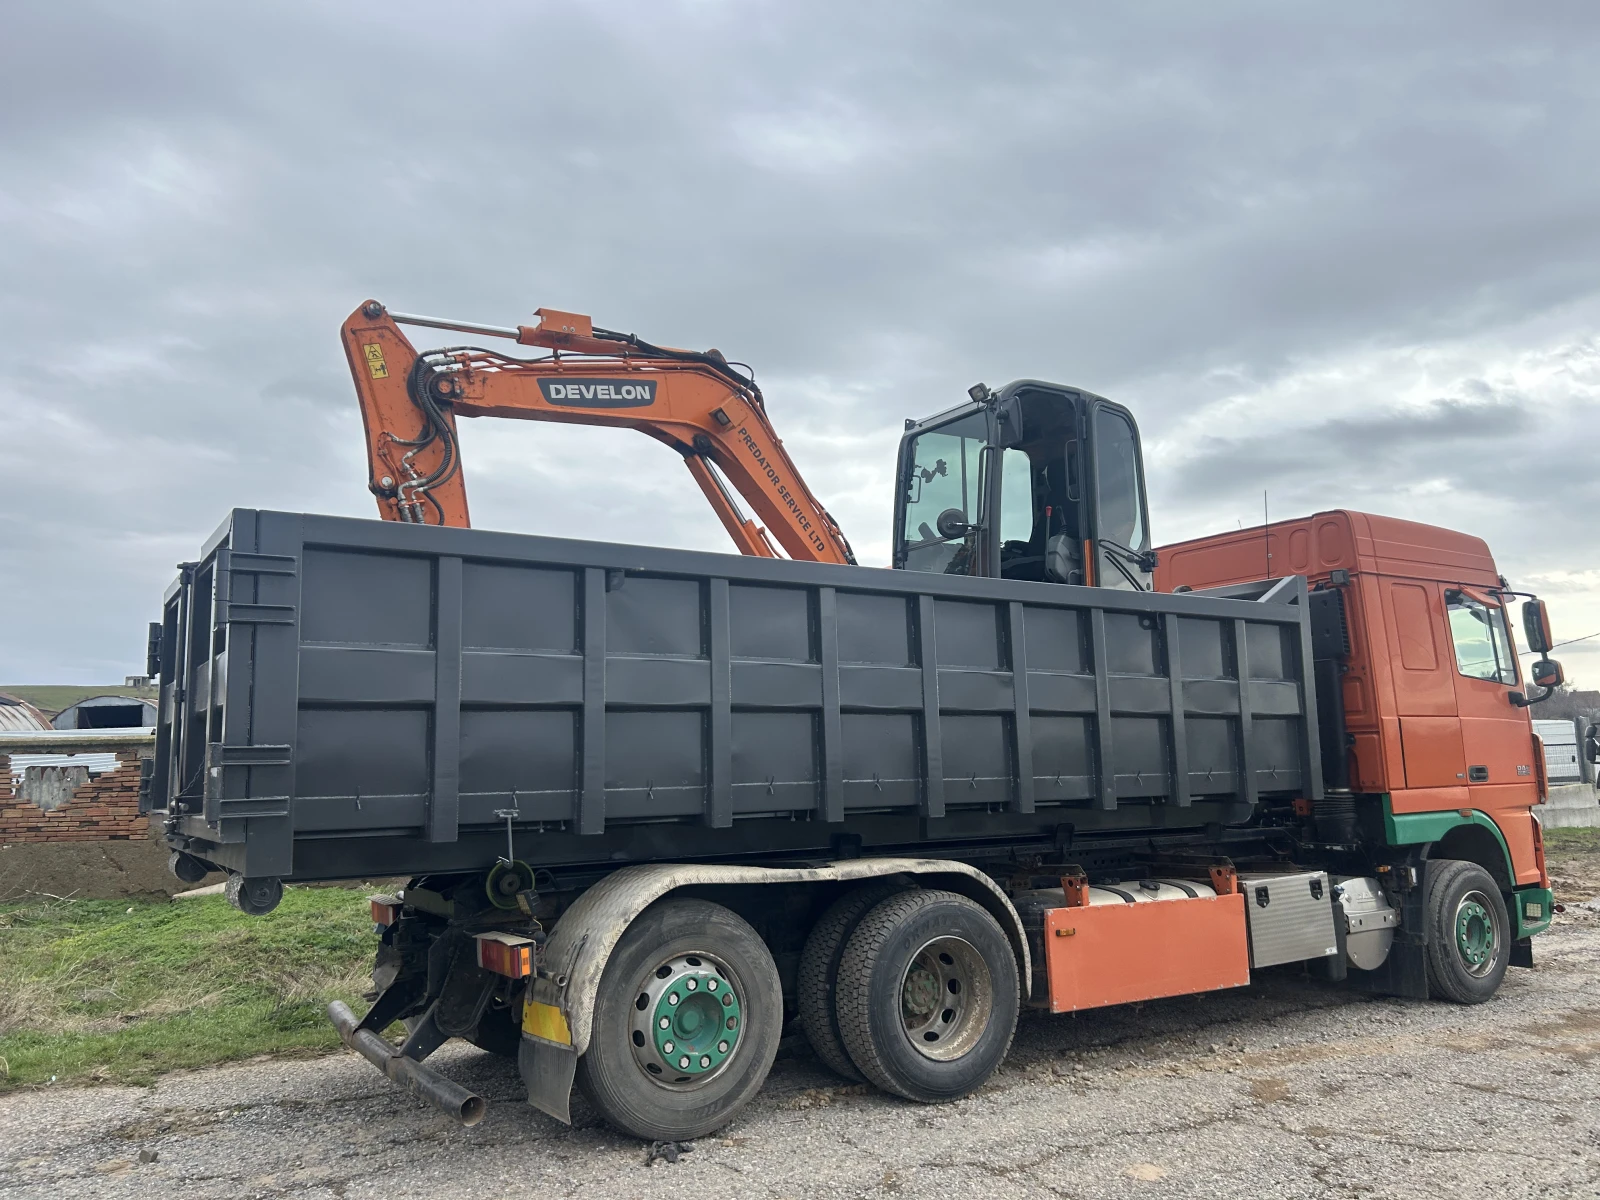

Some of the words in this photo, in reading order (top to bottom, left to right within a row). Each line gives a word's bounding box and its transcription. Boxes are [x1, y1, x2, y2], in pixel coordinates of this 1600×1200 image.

[549, 384, 651, 400] DEVELON
[737, 427, 780, 487] PREDATOR
[777, 485, 812, 532] SERVICE
[808, 530, 825, 552] LTD
